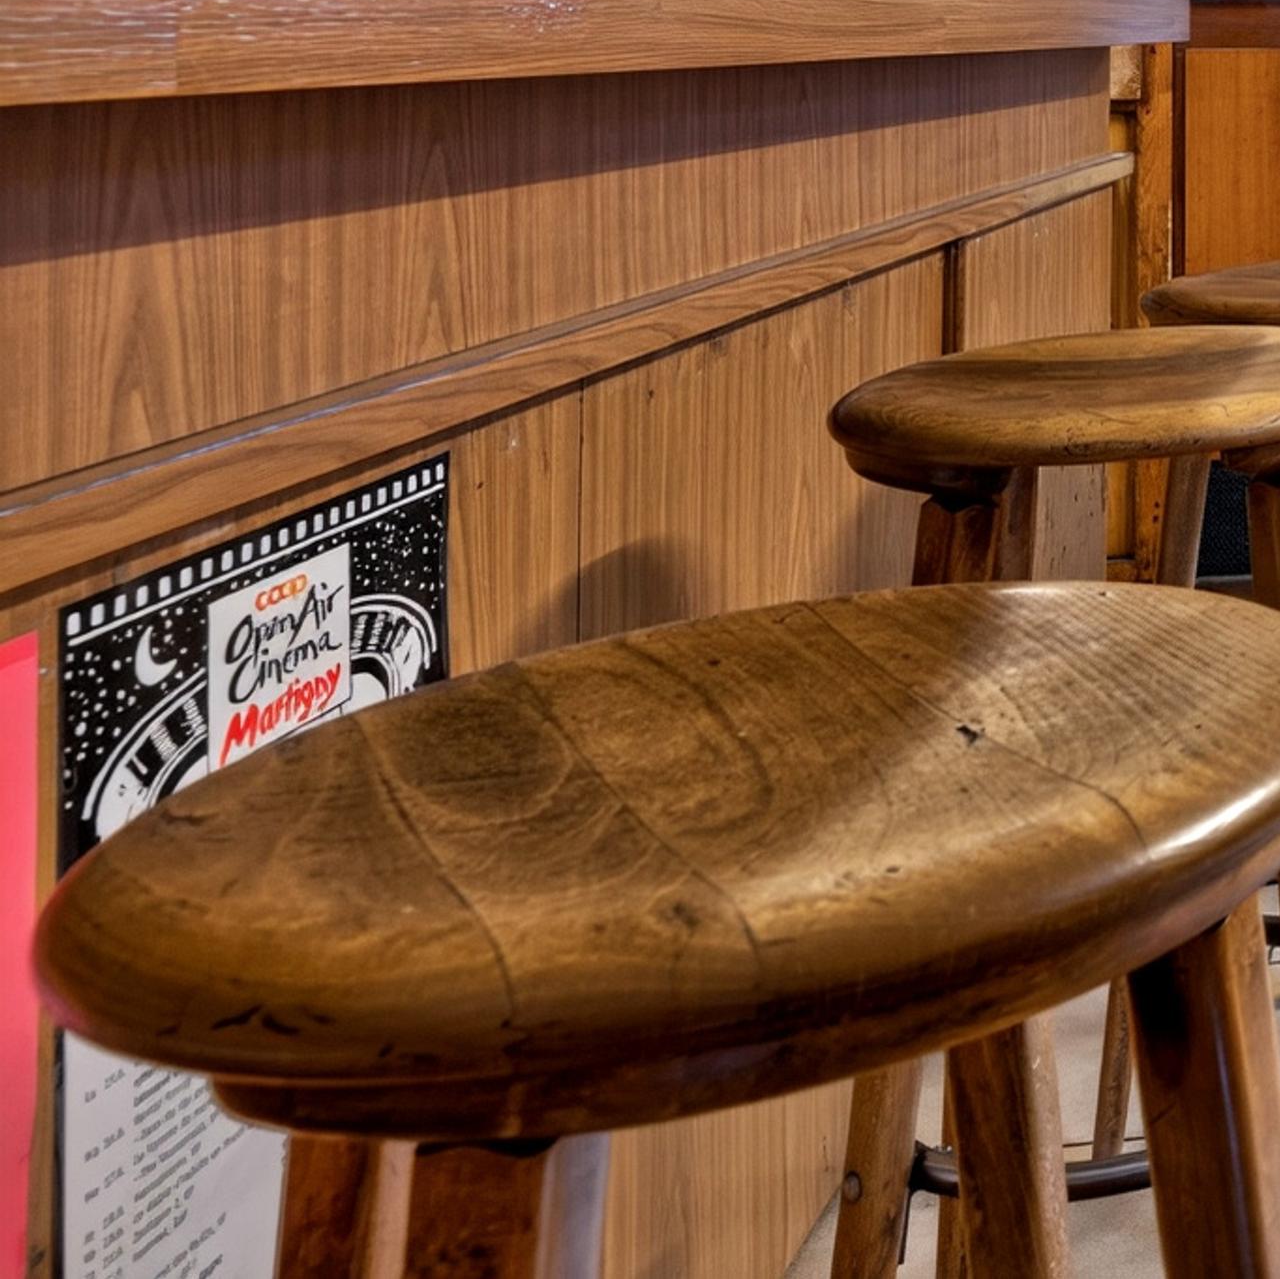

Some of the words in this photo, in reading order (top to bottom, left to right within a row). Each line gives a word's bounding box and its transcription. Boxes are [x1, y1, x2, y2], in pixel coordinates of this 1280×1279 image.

[225, 605, 300, 666] Open
[289, 581, 346, 644] Air
[228, 626, 343, 704] Cinema
[219, 662, 343, 768] Martigny
